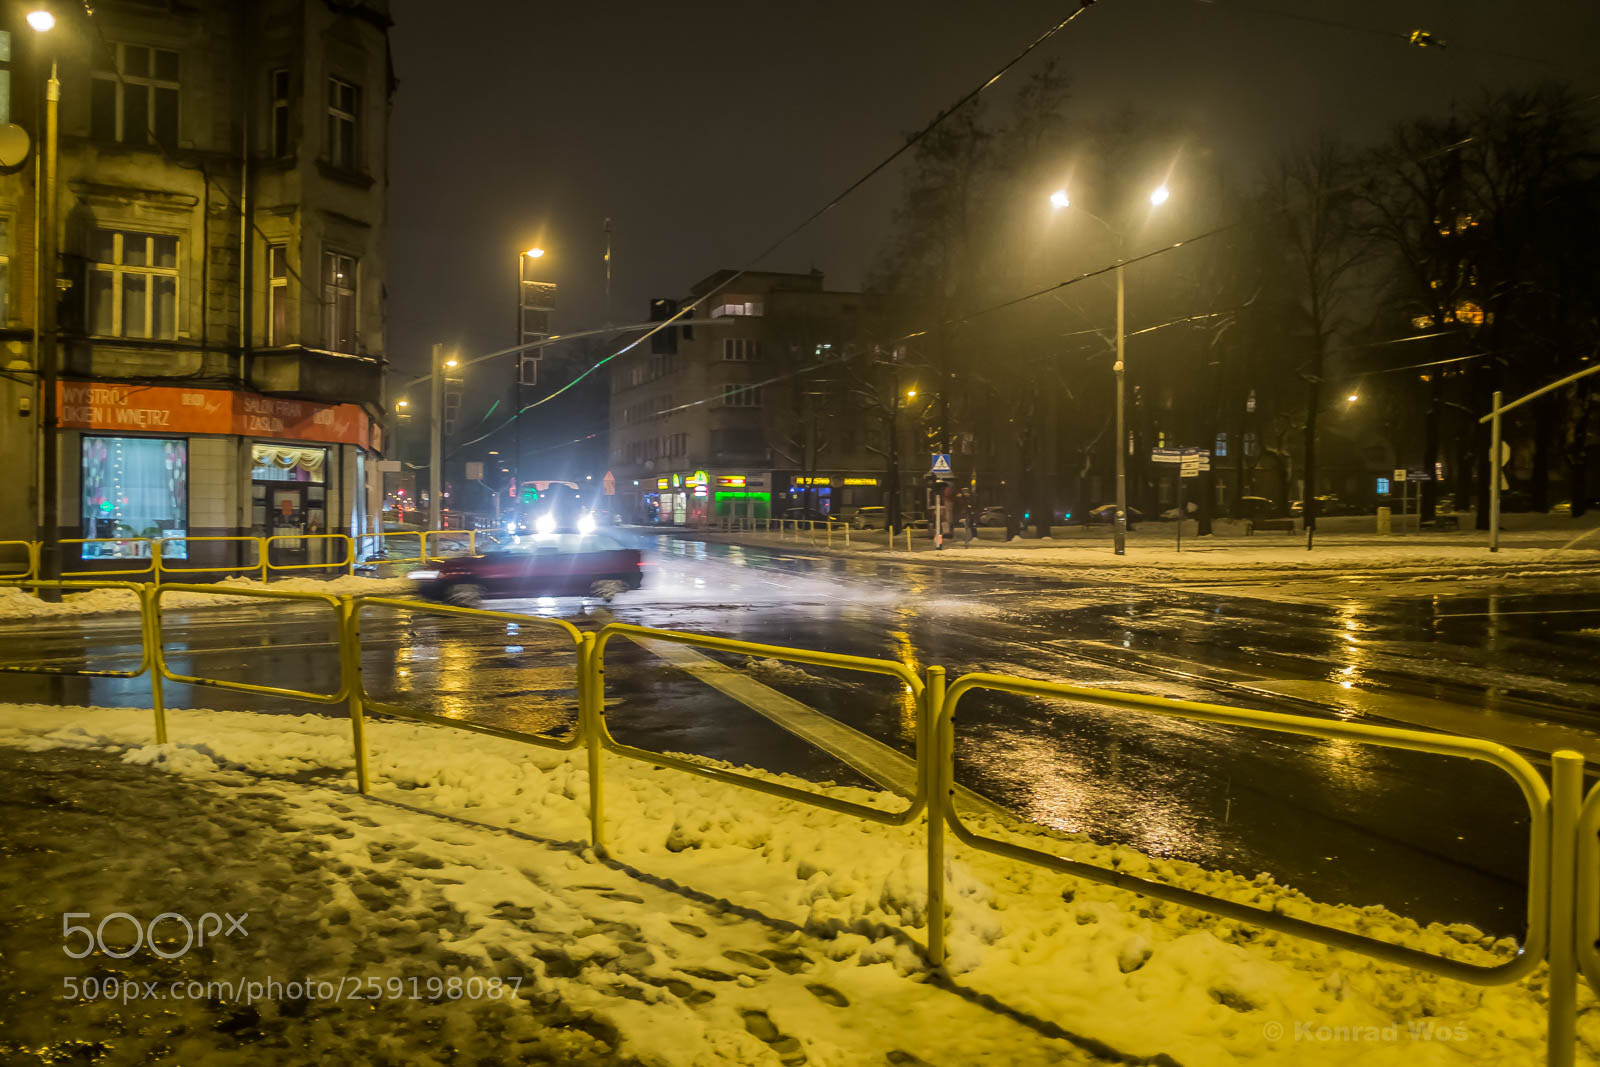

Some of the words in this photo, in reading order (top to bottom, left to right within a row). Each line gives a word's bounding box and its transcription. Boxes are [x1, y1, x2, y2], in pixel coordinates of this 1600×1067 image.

[63, 386, 128, 406] WYSTRÓJ
[63, 405, 103, 424] OKIEN
[116, 408, 170, 428] WNĘTRZ
